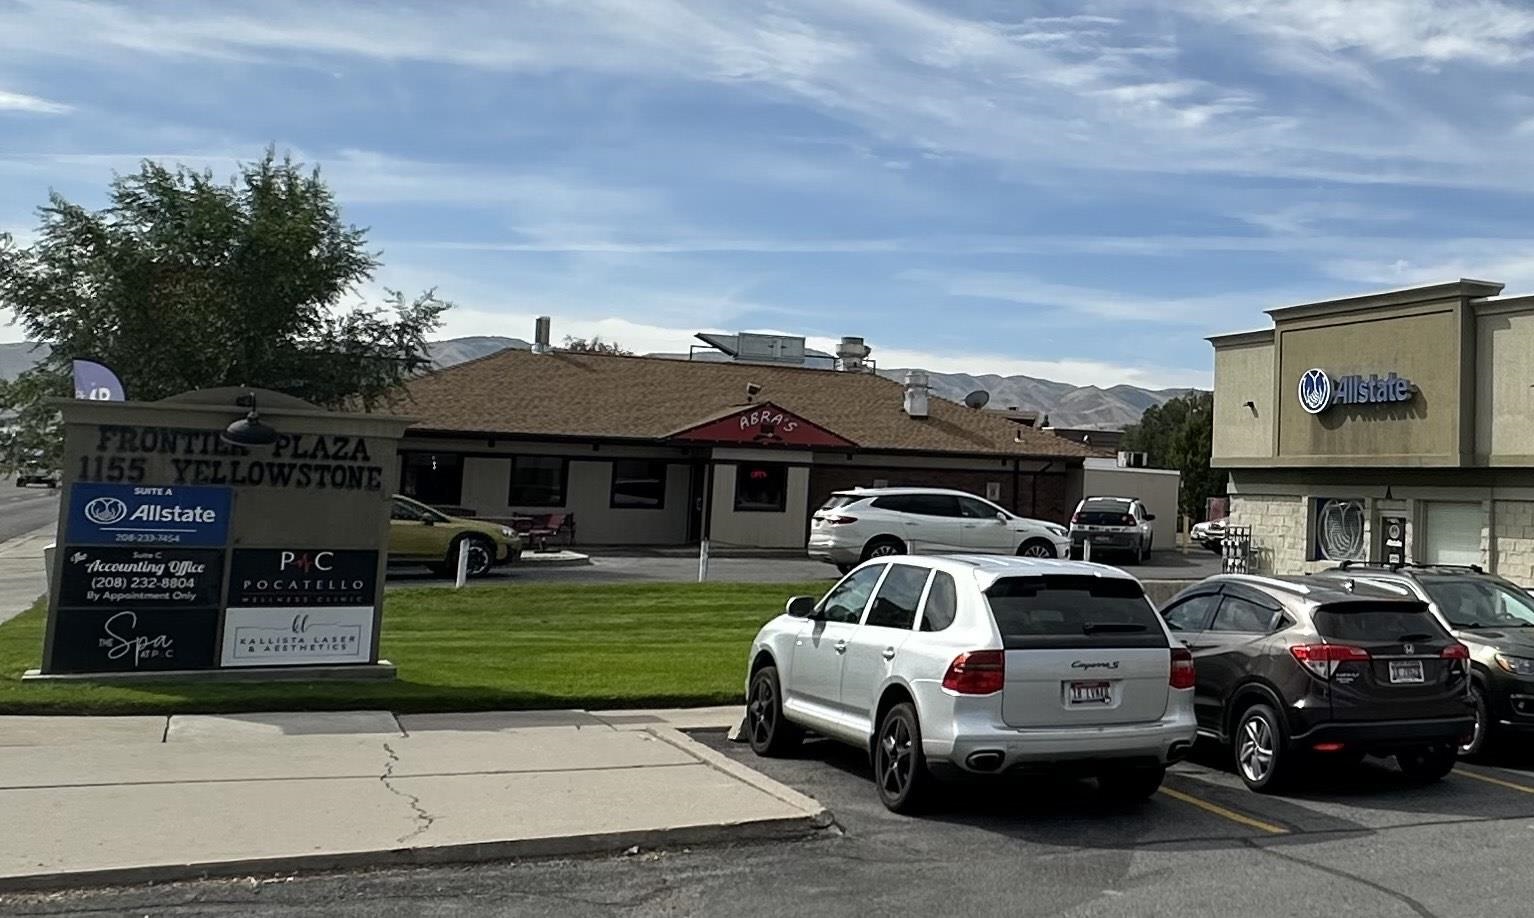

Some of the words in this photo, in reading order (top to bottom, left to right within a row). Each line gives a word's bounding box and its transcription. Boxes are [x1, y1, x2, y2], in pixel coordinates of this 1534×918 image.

[1333, 373, 1411, 404] Allstate
[740, 410, 798, 431] ABRA'S
[272, 433, 371, 462] PLAZA
[79, 455, 146, 482] 1155
[170, 458, 383, 492] YELLOWSTONE
[133, 487, 162, 496] SUITE
[164, 488, 173, 496] A
[129, 504, 216, 522] Allstate
[132, 551, 154, 559] Suite
[155, 551, 162, 559] C
[85, 560, 166, 576] Accounting
[168, 560, 206, 576] Office
[91, 577, 127, 589] (208)
[130, 577, 195, 589] 232-8804
[243, 580, 364, 590] POCATELLO
[87, 591, 99, 600] By
[102, 591, 170, 601] Appointment
[172, 591, 197, 601] Only
[105, 611, 173, 667] Spa
[239, 636, 305, 645] KALLISTA
[263, 644, 347, 652] AESTHETICS
